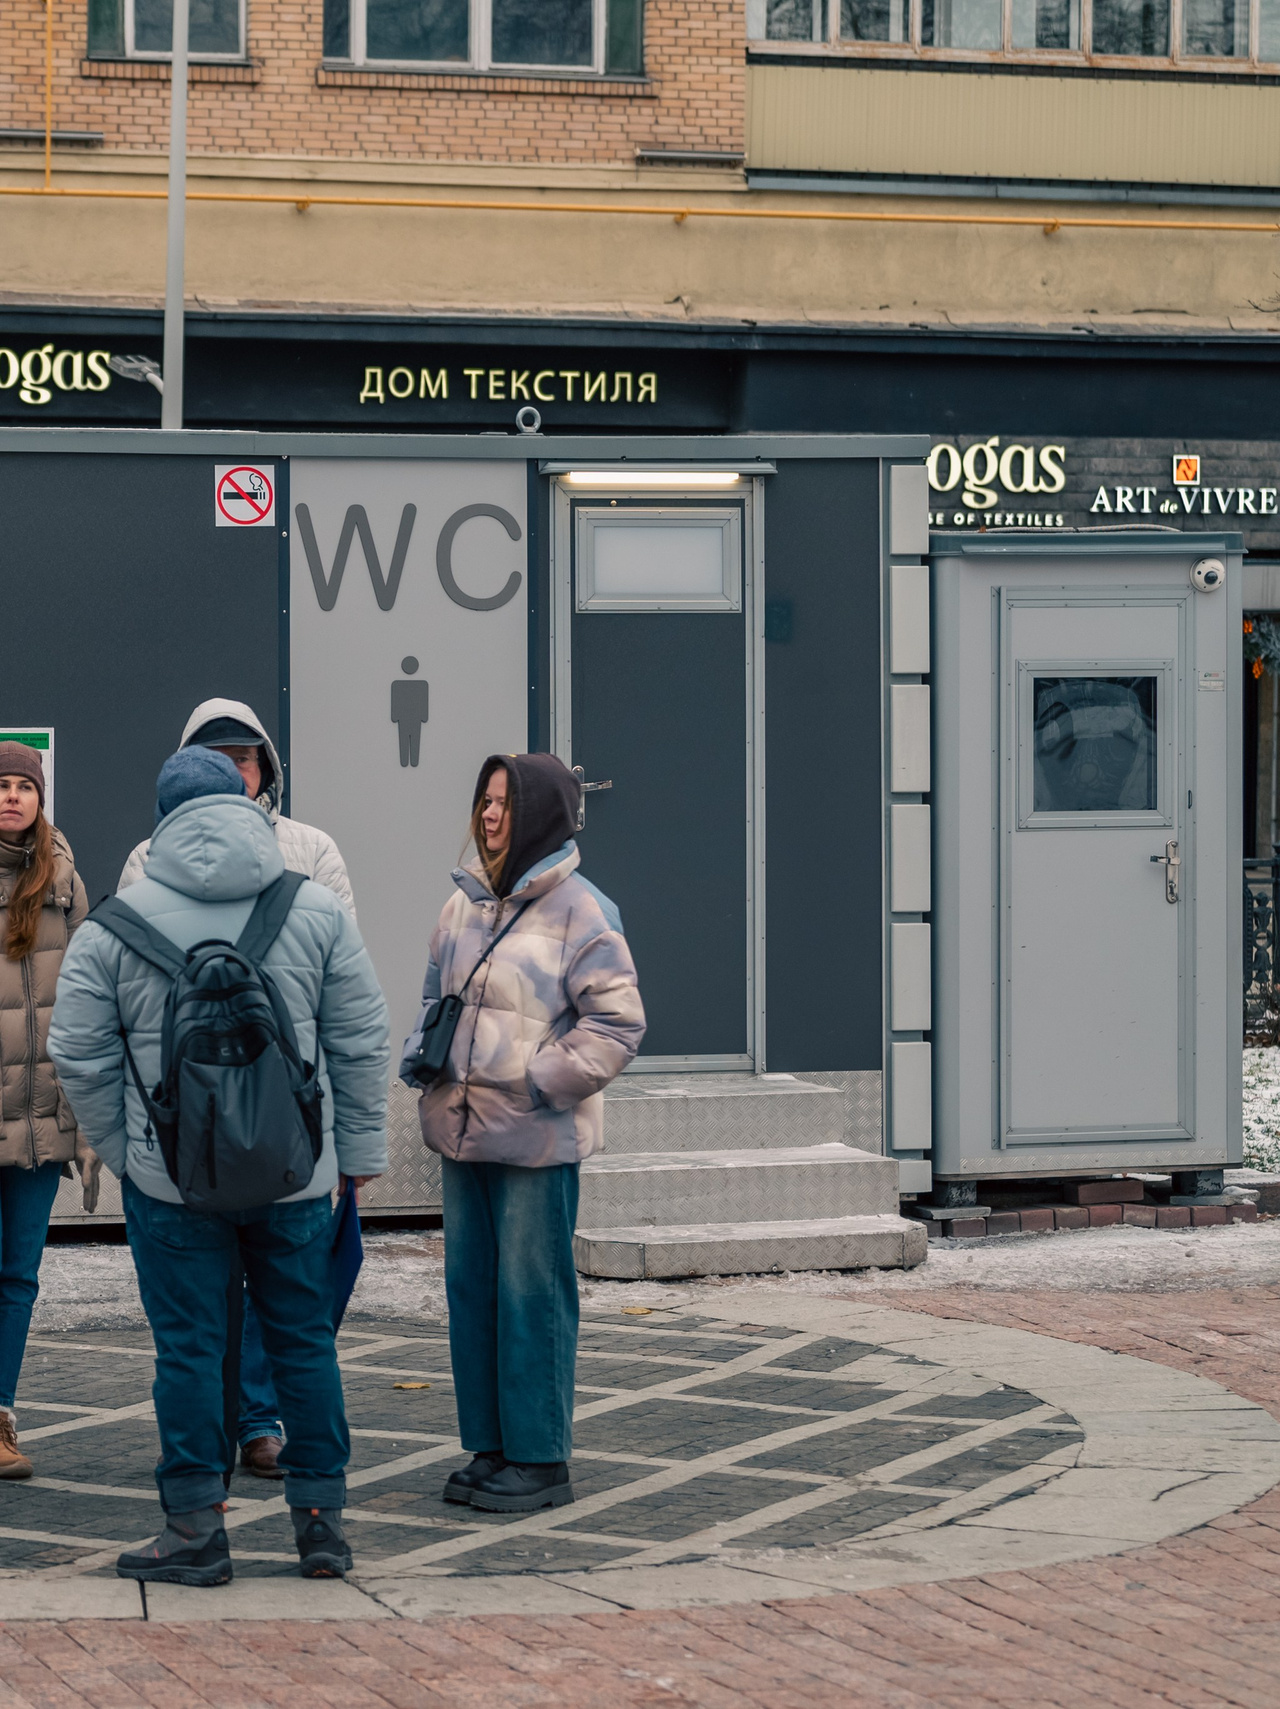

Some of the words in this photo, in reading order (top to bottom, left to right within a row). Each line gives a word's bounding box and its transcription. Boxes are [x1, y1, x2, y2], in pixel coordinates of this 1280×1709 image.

[360, 366, 448, 404] ДОМ
[463, 368, 657, 403] ТЕКСТИЛЯ
[926, 435, 1066, 509] ogas
[1089, 485, 1157, 514] ART
[1159, 499, 1178, 514] de
[1177, 487, 1278, 514] VIVRE
[953, 512, 975, 526] OF
[984, 512, 1064, 527] TEXTILES
[295, 502, 522, 611] WC
